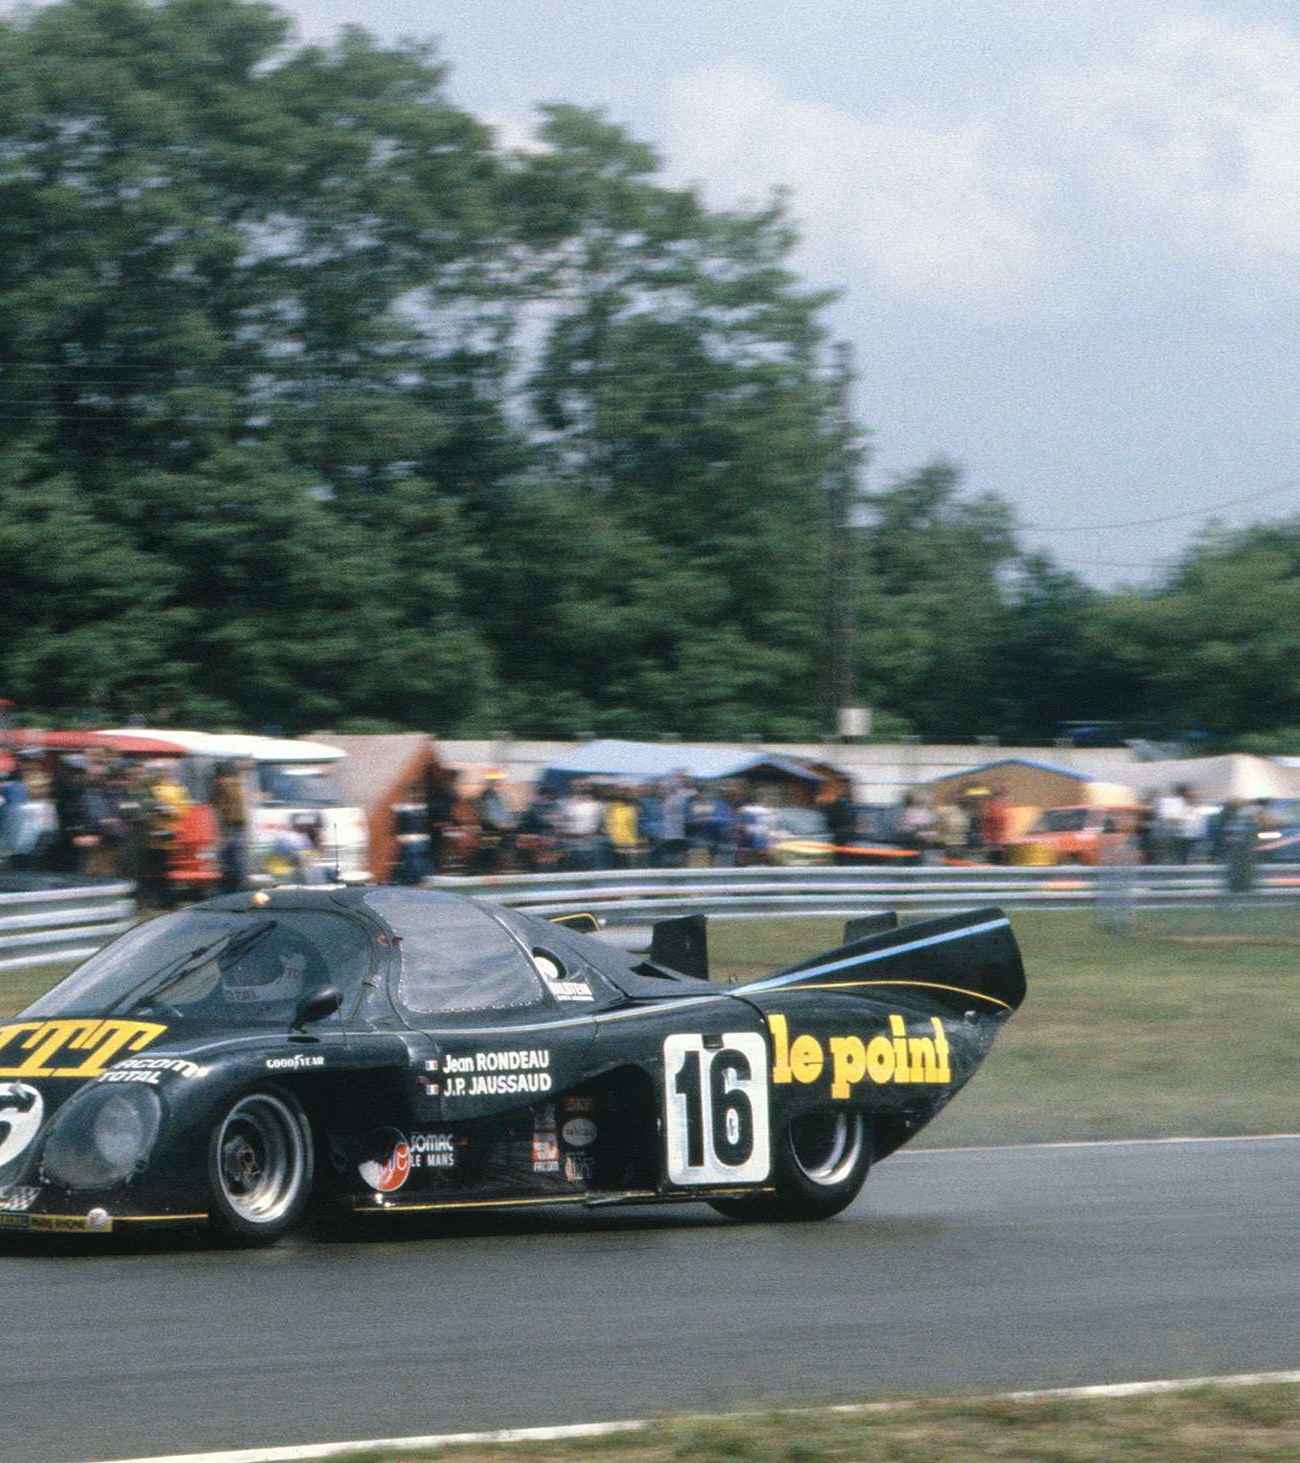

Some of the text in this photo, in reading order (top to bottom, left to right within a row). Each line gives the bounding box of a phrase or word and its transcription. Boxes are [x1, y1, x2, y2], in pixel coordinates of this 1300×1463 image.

[265, 1054, 324, 1070] GOODYEAR
[443, 1050, 550, 1073] Jean RONDEAU
[768, 1013, 951, 1099] le point
[98, 1071, 162, 1085] TOTAL
[443, 1072, 552, 1096] J.P. JAUSSAUD
[675, 1048, 754, 1168] 16
[410, 1153, 455, 1168] LE MANS
